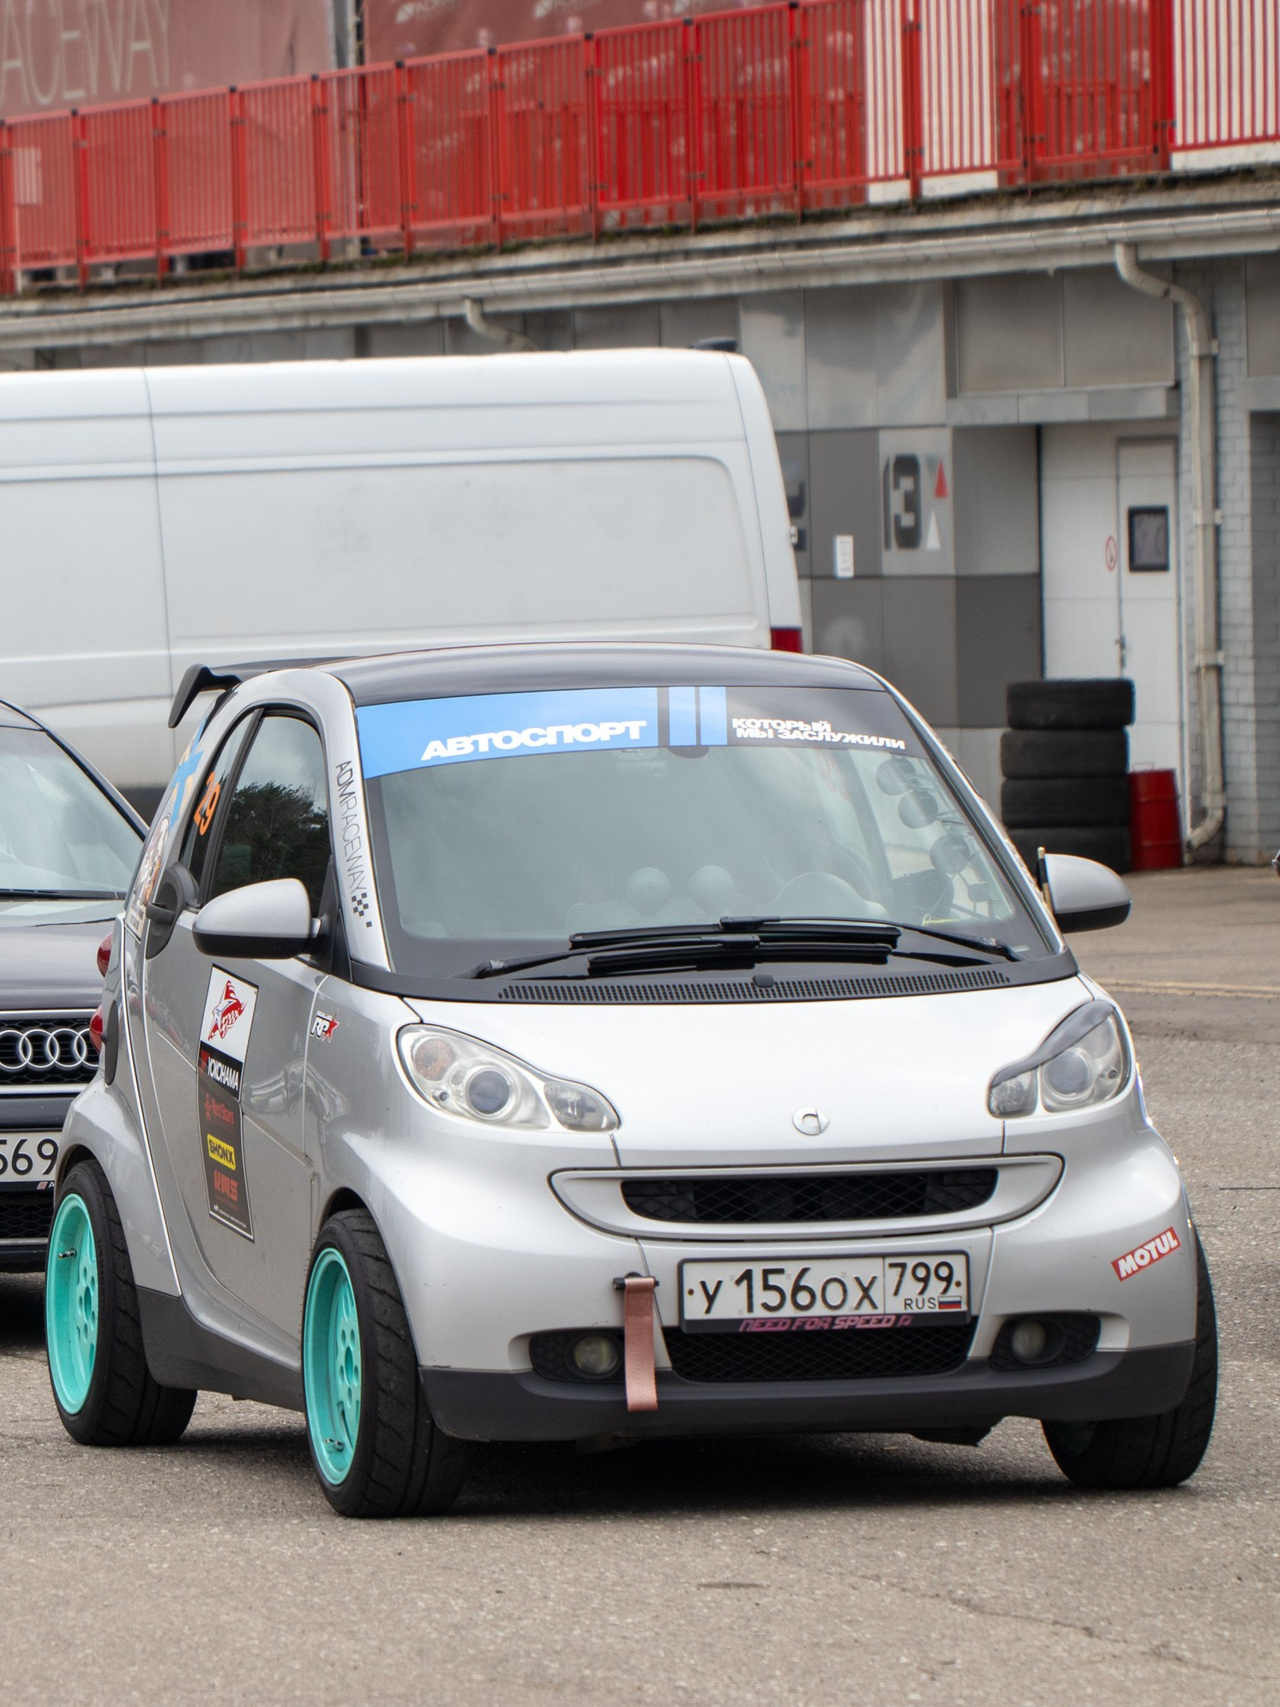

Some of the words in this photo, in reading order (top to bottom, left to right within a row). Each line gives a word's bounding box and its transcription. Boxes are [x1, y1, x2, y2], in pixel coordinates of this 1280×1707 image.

[732, 709, 832, 733] КОТОРЫЙ
[421, 720, 647, 761] АВТОСПОРТ
[736, 728, 774, 739] МЫ
[778, 731, 906, 750] ЗАСЛУЖИЛИ
[193, 770, 221, 835] 29
[207, 1056, 239, 1091] YOKOHAMA
[208, 1138, 234, 1166] SHONX
[1117, 1231, 1179, 1279] MOTUL
[888, 1261, 954, 1297] 799
[903, 1298, 937, 1310] RUS
[738, 1318, 790, 1332] NEED
[791, 1317, 832, 1331] FOR
[833, 1315, 897, 1328] SPEED
